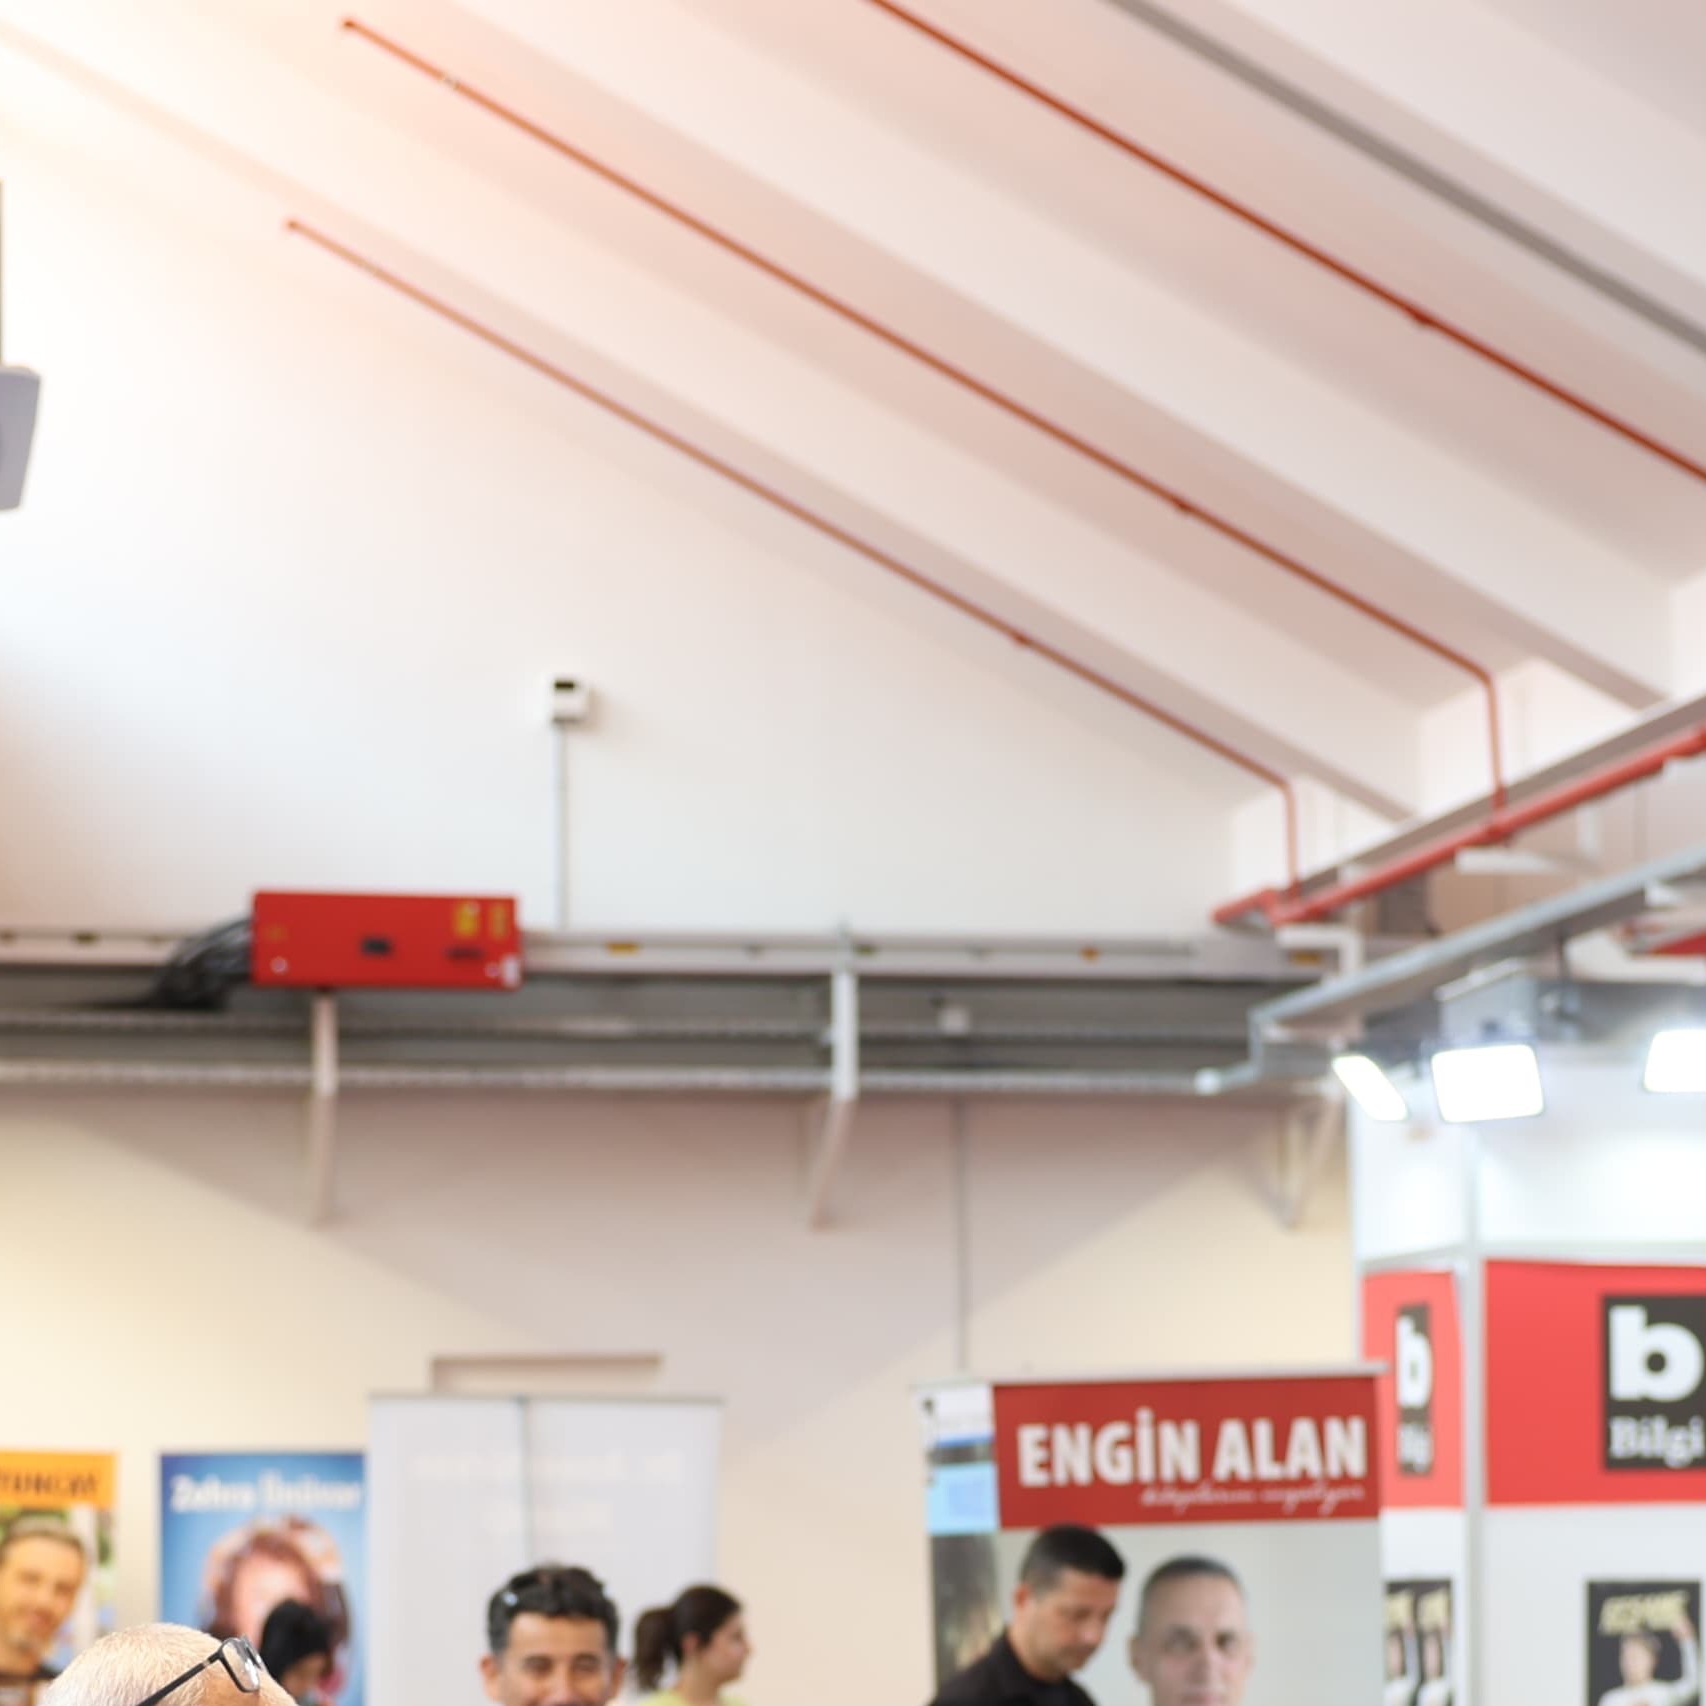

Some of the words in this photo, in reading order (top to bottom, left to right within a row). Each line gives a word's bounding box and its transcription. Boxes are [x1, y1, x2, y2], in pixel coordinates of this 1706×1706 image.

[1609, 1305, 1704, 1401] b
[1017, 1407, 1201, 1486] ENGİN
[1212, 1415, 1367, 1481] ALAN
[1609, 1417, 1704, 1467] Bilgi
